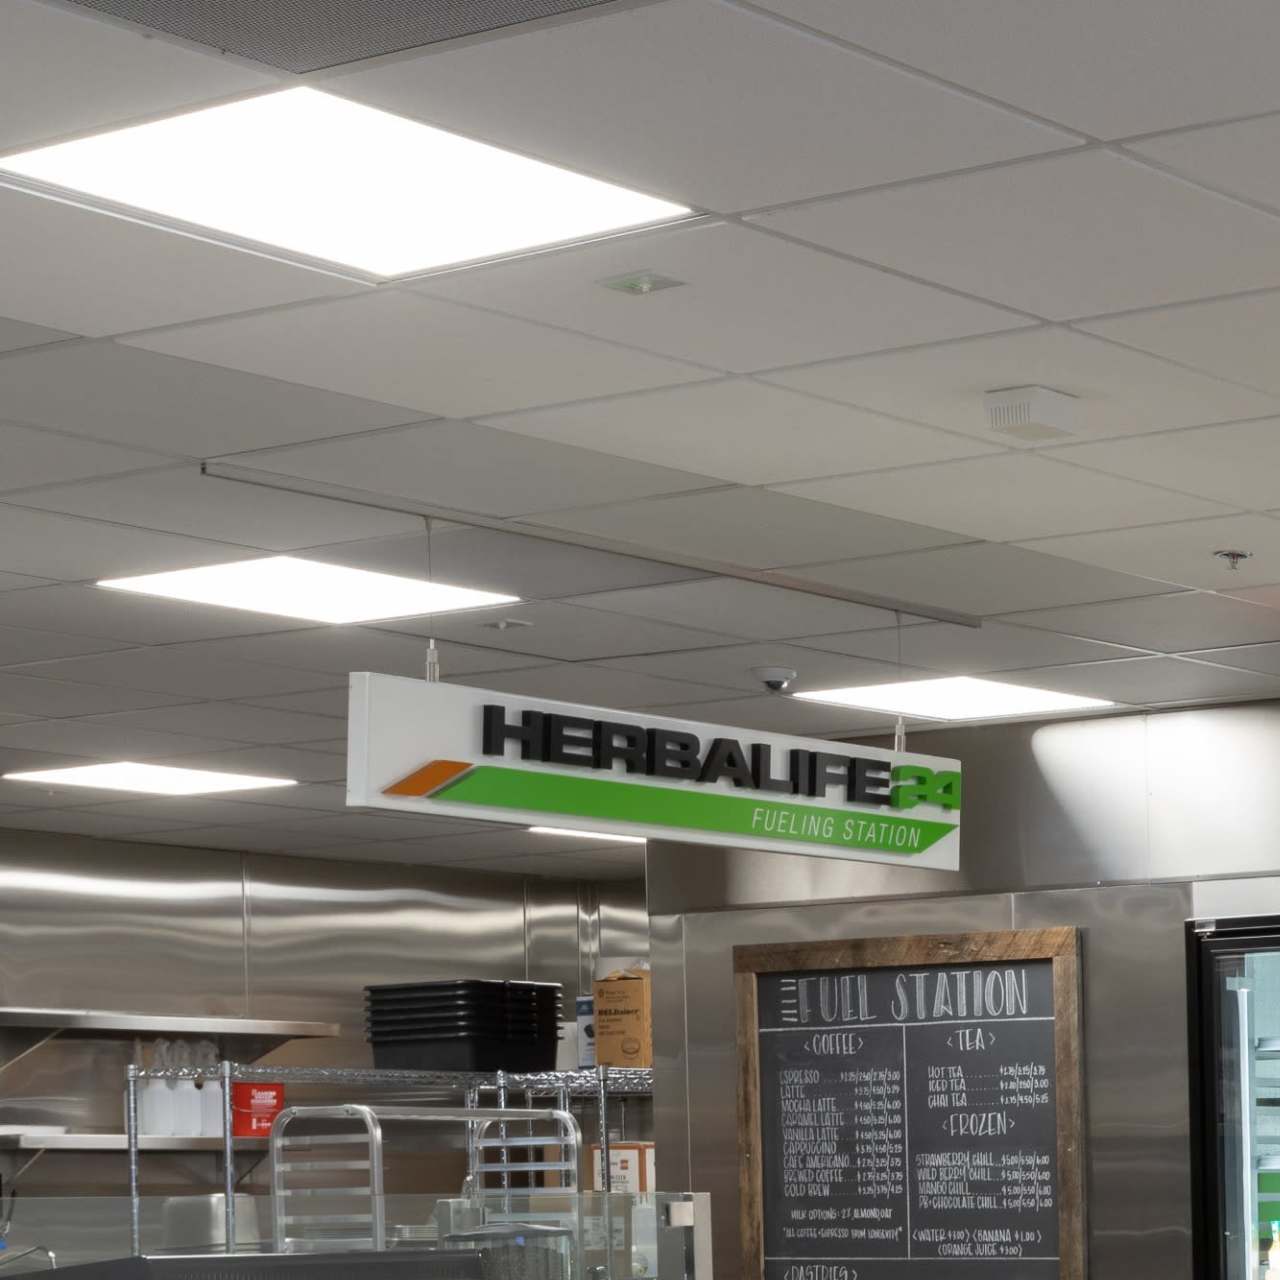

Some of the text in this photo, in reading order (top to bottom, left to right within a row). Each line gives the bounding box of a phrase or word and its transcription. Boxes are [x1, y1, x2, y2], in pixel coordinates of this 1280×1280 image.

[752, 807, 921, 849] FUELING STATION
[798, 968, 1028, 1023] FUEL STATION
[928, 1065, 945, 1078] HOT
[947, 1064, 964, 1078] TEA
[780, 1085, 806, 1099] LATTE
[929, 1079, 948, 1092] ICED
[949, 1078, 967, 1092] TEA
[812, 1097, 837, 1112] LATTE
[951, 1092, 968, 1106] TEA
[820, 1112, 845, 1126] LATTE
[783, 1126, 815, 1141] VANILLA
[816, 1126, 840, 1140] LATTE
[915, 1150, 970, 1169] STRAWBERRY
[973, 1152, 994, 1167] CHILL
[917, 1167, 938, 1181] WILD
[939, 1164, 967, 1182] BERRY
[969, 1167, 991, 1181] CHILL
[919, 1182, 948, 1196] MANGO
[948, 1182, 970, 1196] CHILL
[977, 1195, 998, 1209] CHILL
[974, 1242, 998, 1256] JUICE
